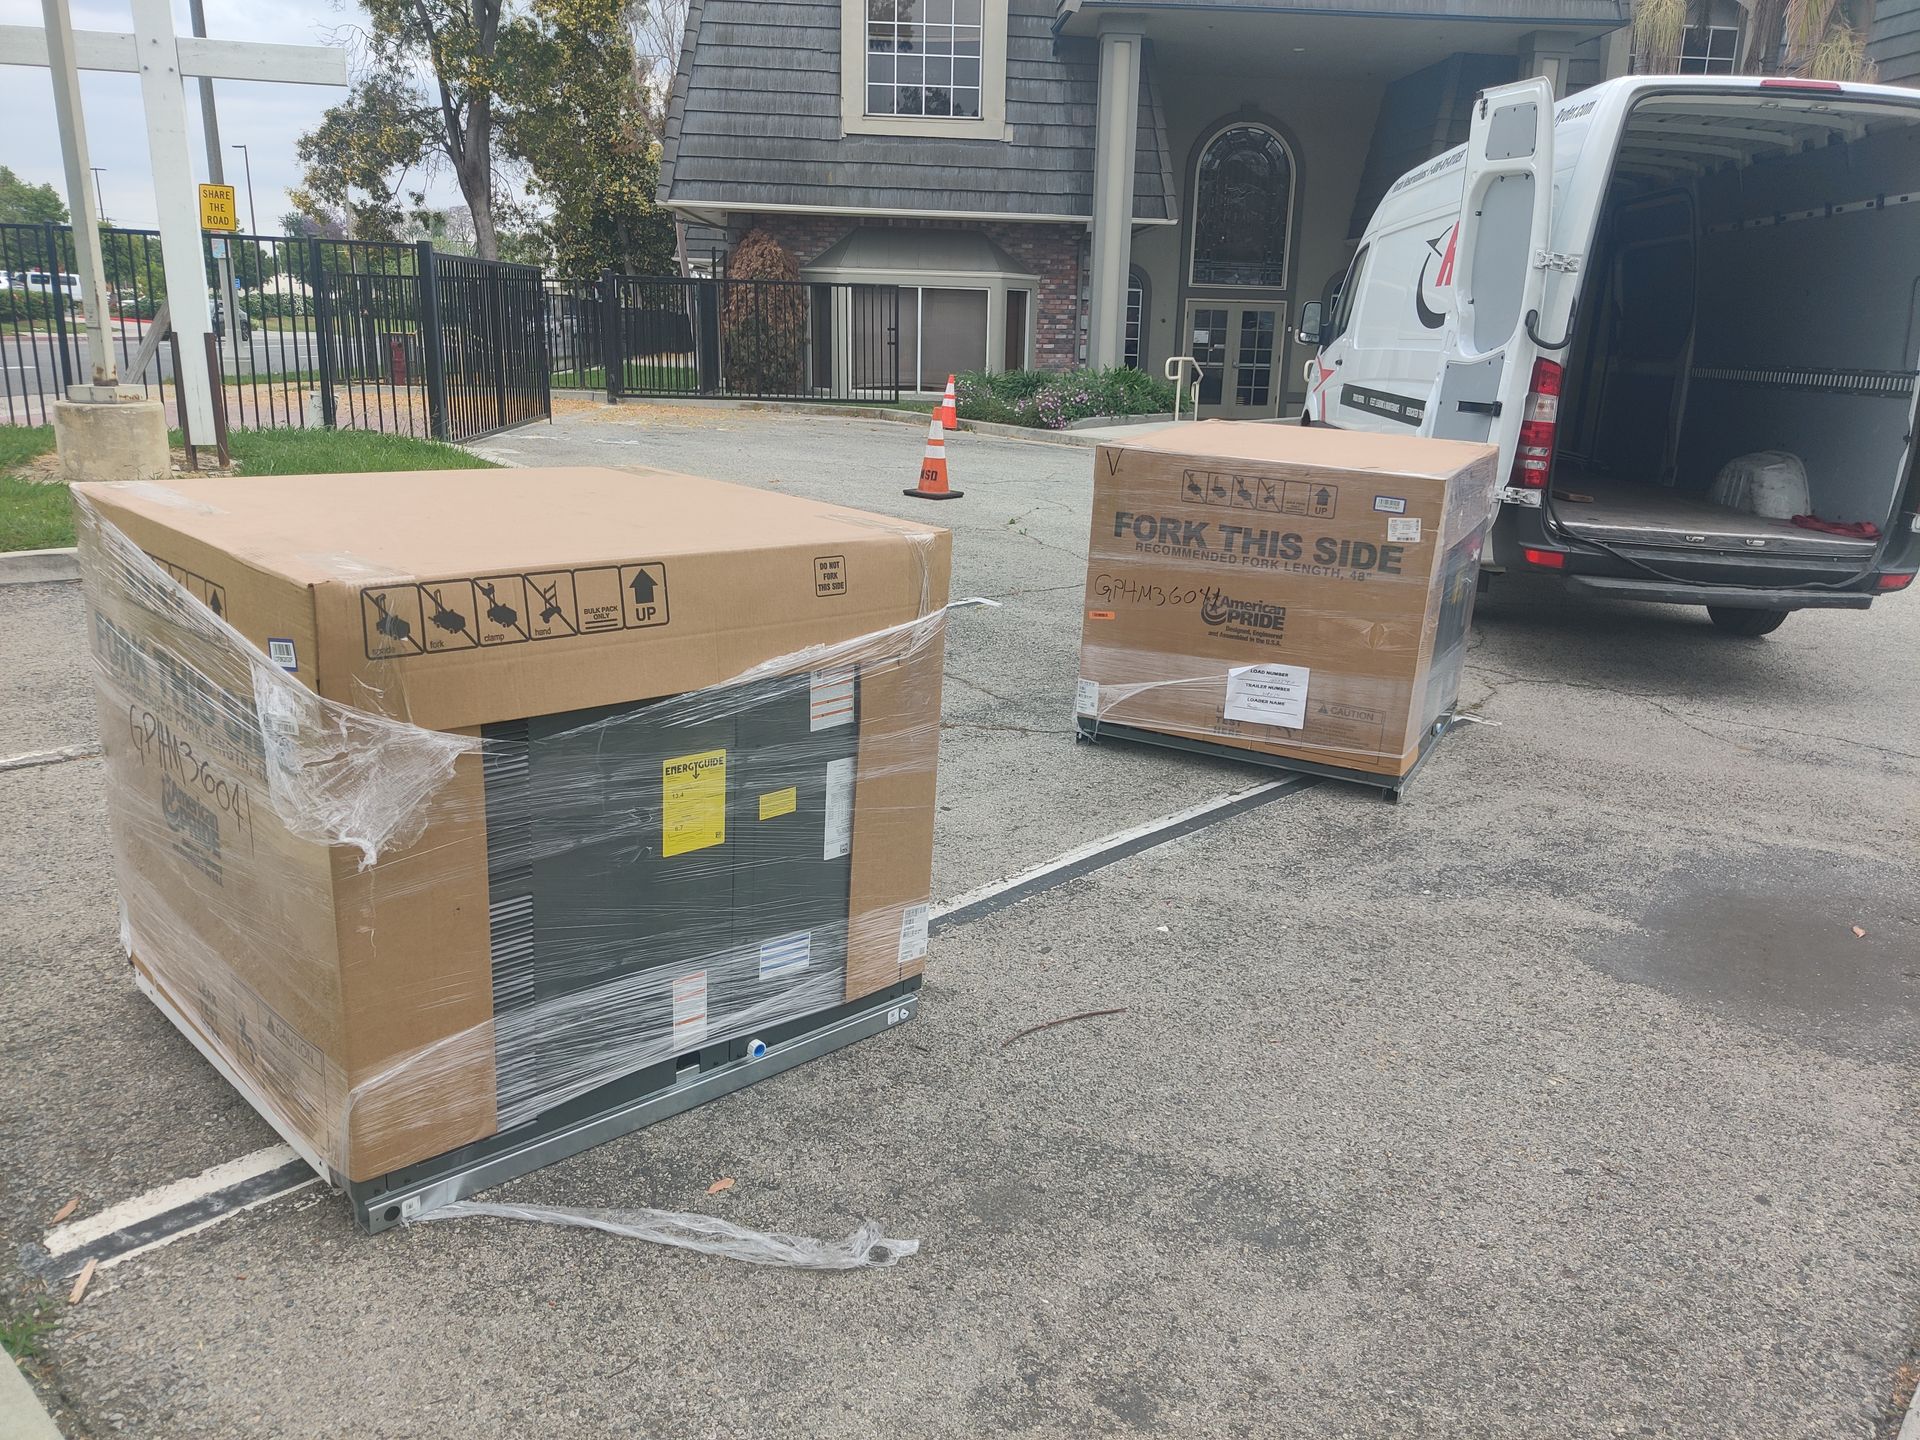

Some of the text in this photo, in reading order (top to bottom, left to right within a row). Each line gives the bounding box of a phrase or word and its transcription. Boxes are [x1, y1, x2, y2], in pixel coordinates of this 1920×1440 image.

[202, 189, 231, 200] SHARE
[209, 202, 225, 212] THE
[207, 215, 229, 225] ROAD
[1315, 506, 1328, 515] UP
[1113, 511, 1405, 575] FORK THIS SIDE
[819, 561, 840, 570] DO NOT
[1135, 542, 1238, 565] RECOMMENDED
[1241, 556, 1279, 570] FORK
[1284, 561, 1345, 581] LENGTH,
[823, 571, 838, 581] FORK
[818, 581, 844, 592] THIS SIDE
[583, 605, 618, 615] BULK PACK
[1219, 595, 1286, 617] American
[593, 612, 611, 620] ONLY
[635, 606, 657, 622] UP
[1226, 609, 1285, 631] PRIDE
[534, 626, 552, 637] hand
[1252, 630, 1283, 639] Engineered
[484, 632, 505, 643] clamp
[430, 640, 445, 649] fork
[1330, 706, 1374, 721] CAUTION
[276, 1023, 314, 1065] CAUTION
